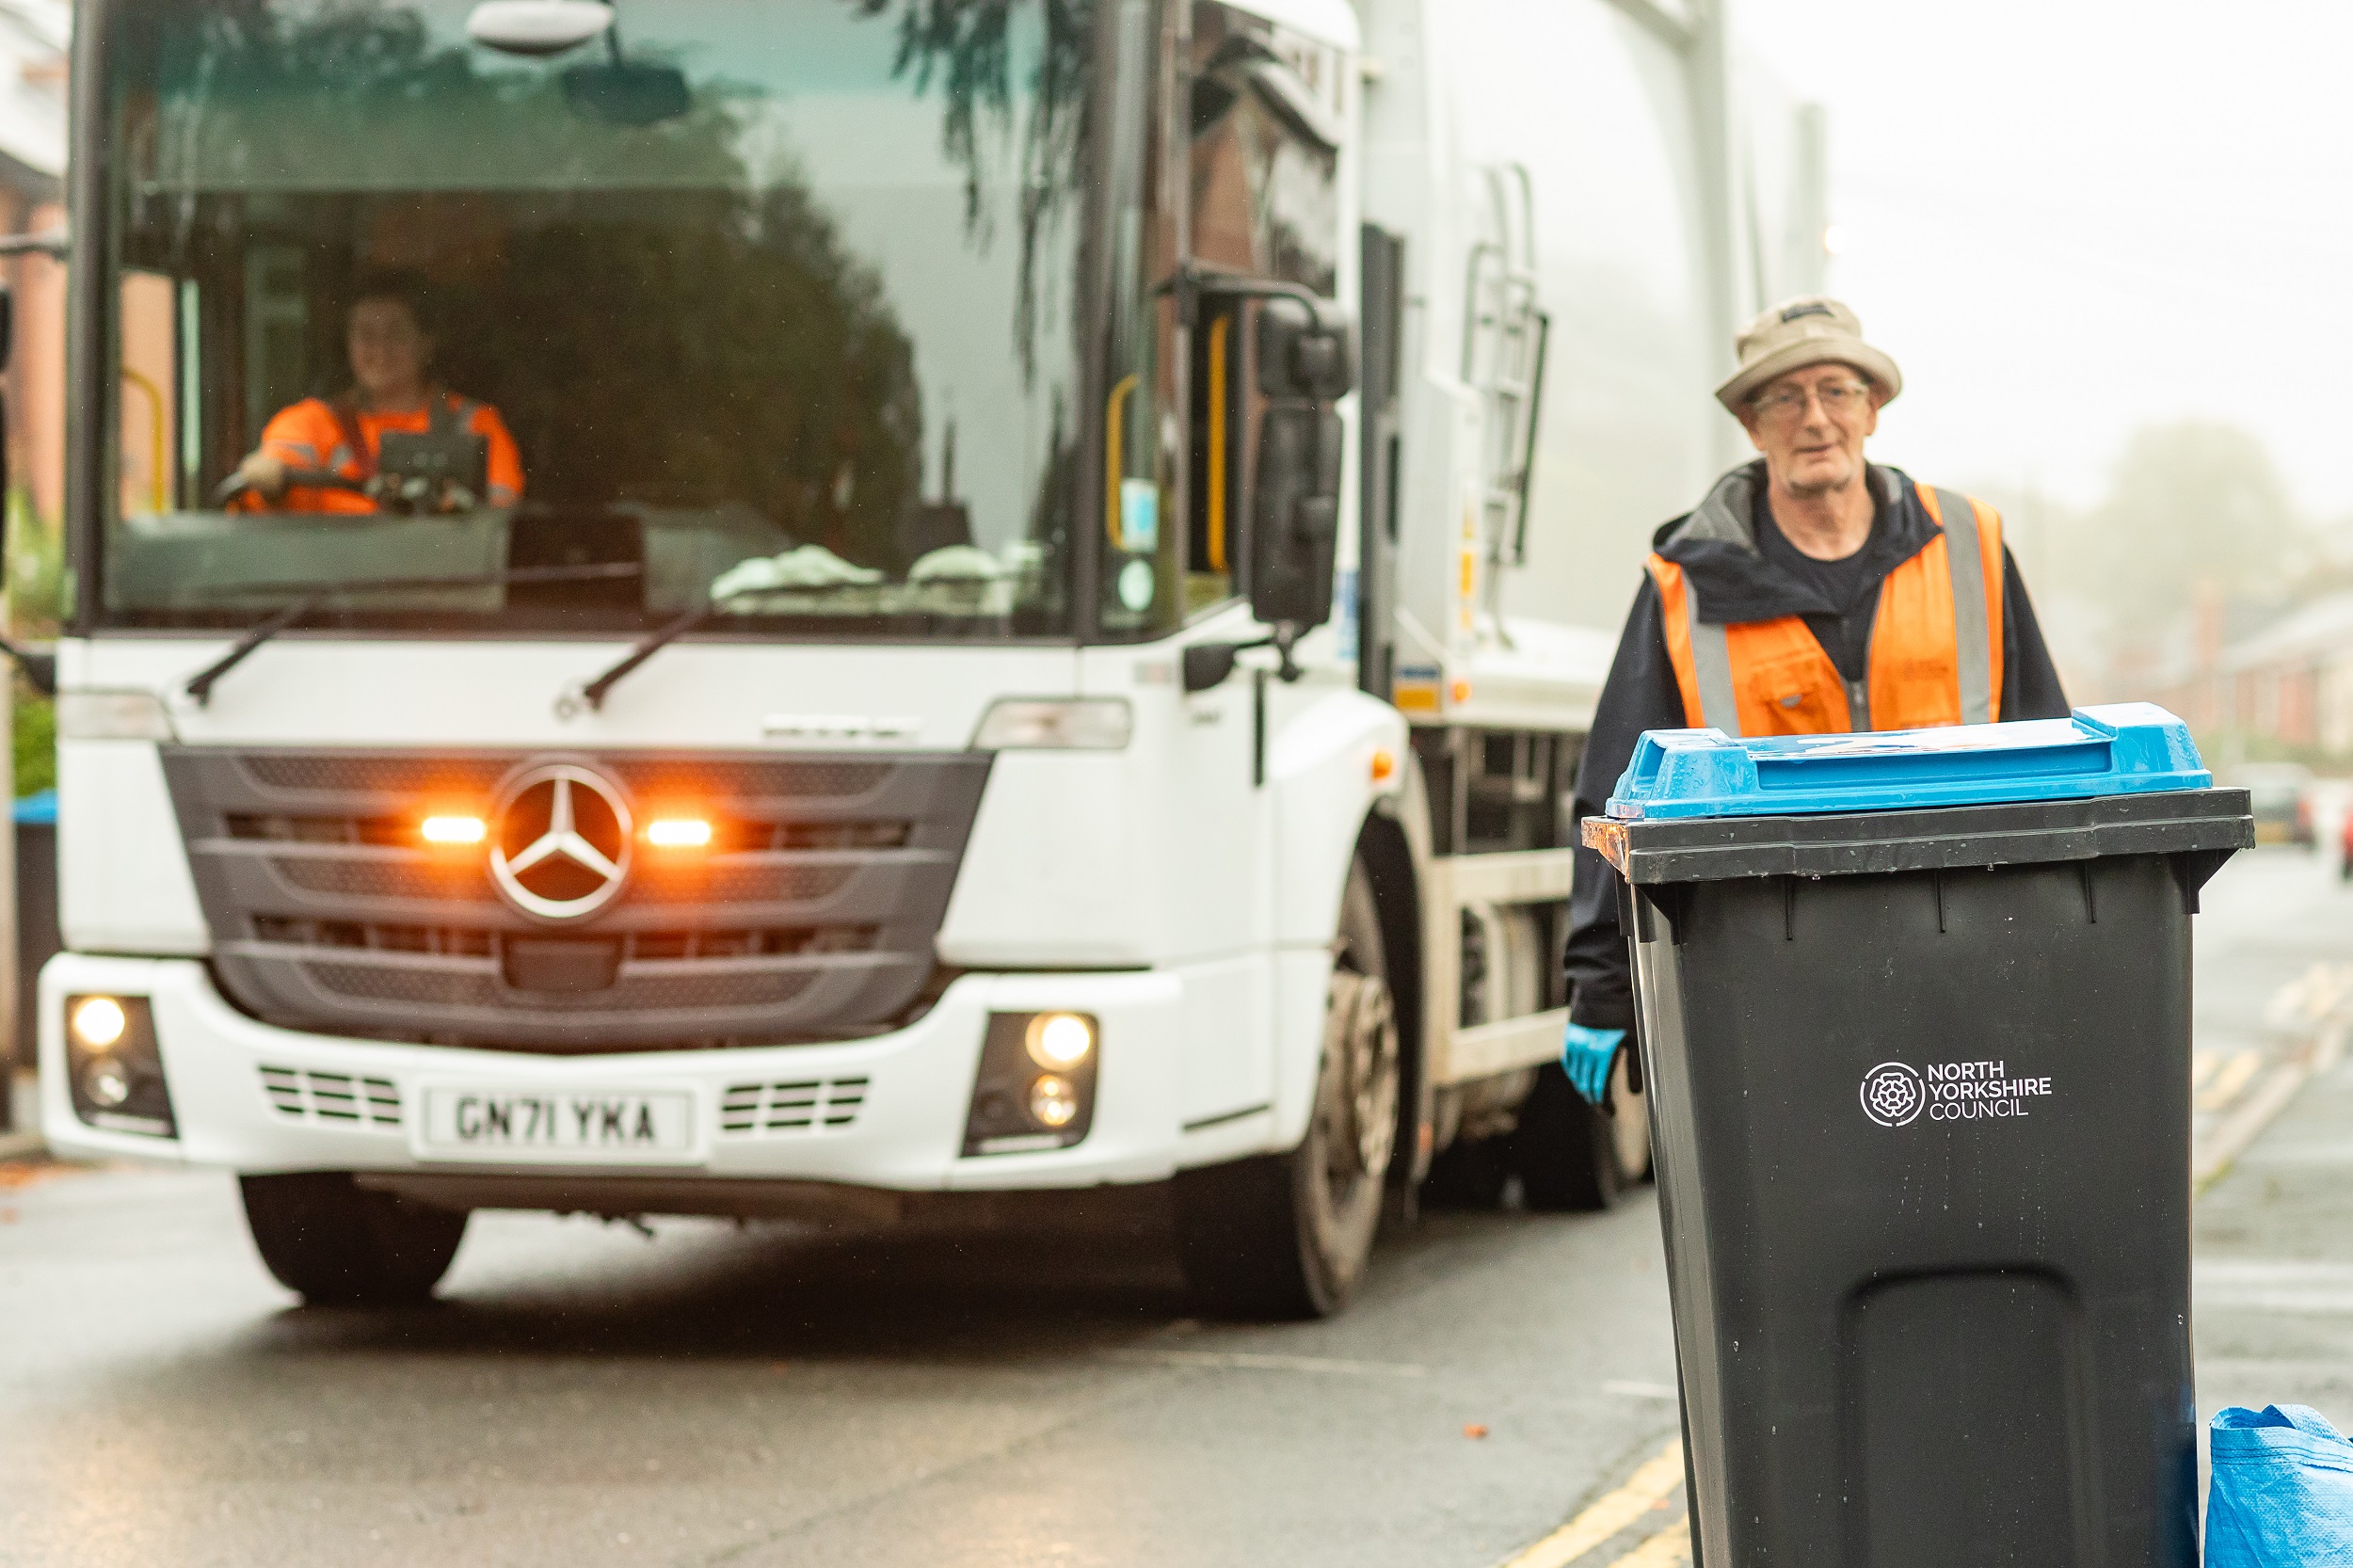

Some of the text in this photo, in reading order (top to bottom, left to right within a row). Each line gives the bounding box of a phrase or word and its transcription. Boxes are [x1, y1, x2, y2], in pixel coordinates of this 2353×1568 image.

[1928, 1060, 2005, 1082] NORTH
[1929, 1077, 2053, 1101] YORKSHIRE
[455, 1095, 655, 1143] GN71 YKA
[1929, 1098, 2029, 1121] COUNCIL
